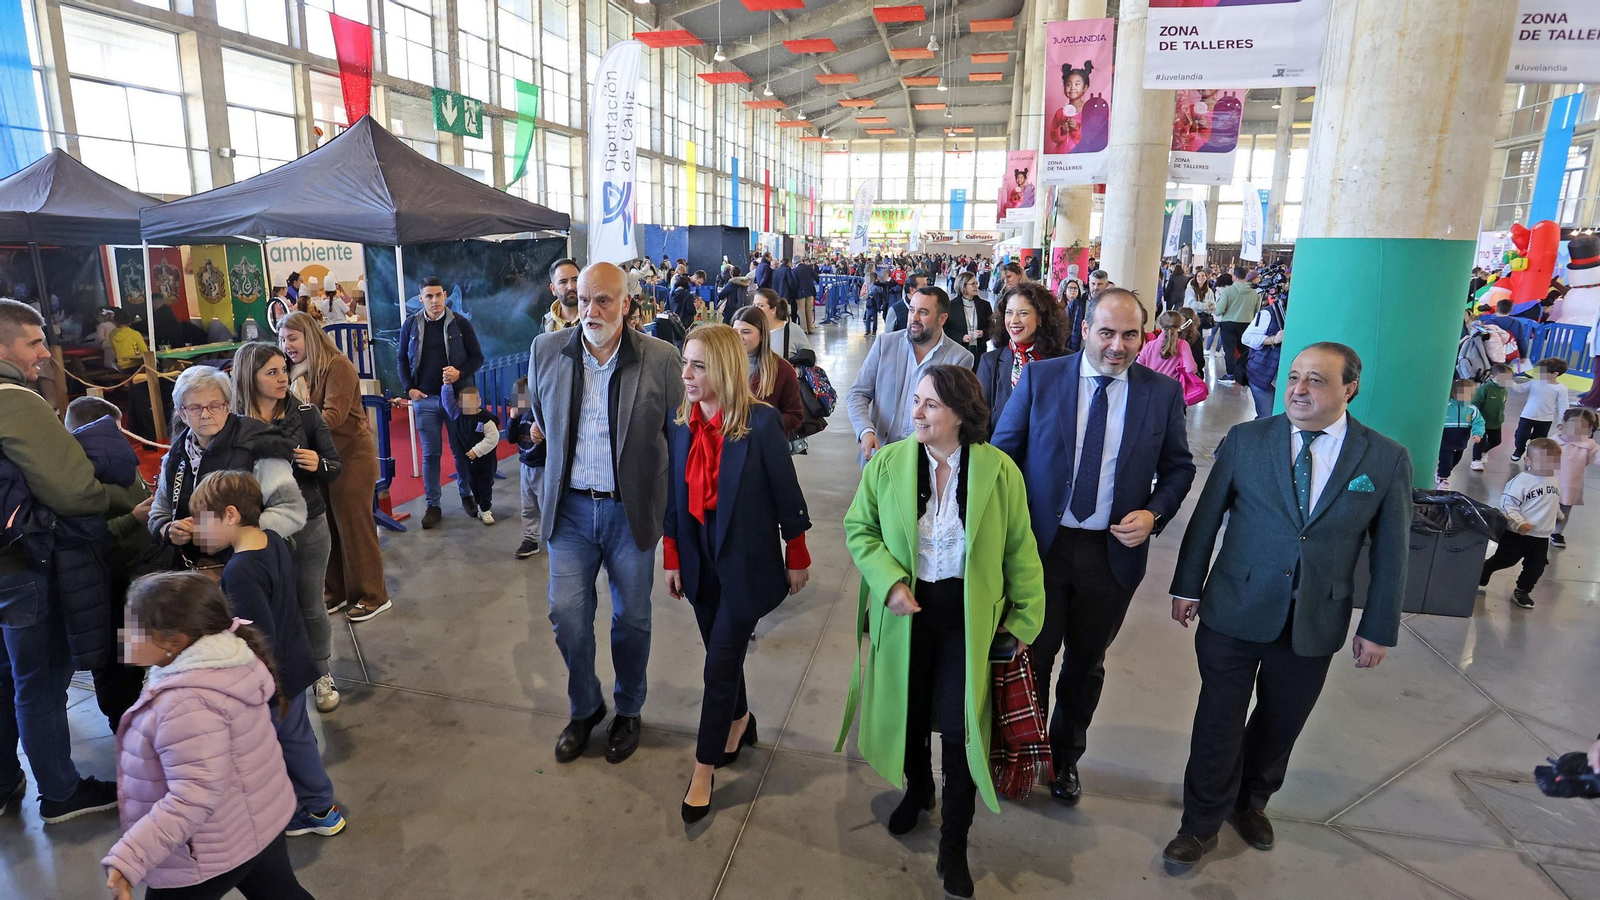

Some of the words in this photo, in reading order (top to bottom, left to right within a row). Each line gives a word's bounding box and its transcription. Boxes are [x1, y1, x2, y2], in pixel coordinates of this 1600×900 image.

[1521, 13, 1568, 24] ZONA
[1159, 26, 1199, 37] ZONA
[1519, 30, 1541, 41] DE
[1548, 29, 1600, 40] TALLE
[1053, 34, 1107, 44] JUVELANDIA
[1159, 41, 1178, 51] DE
[1183, 39, 1254, 50] TALLERES
[1514, 64, 1568, 72] #Juvelandia
[1155, 73, 1203, 81] #Juvelandia
[604, 70, 619, 172] Diputación
[270, 241, 353, 263] ambiente
[1526, 487, 1544, 502] NEW
